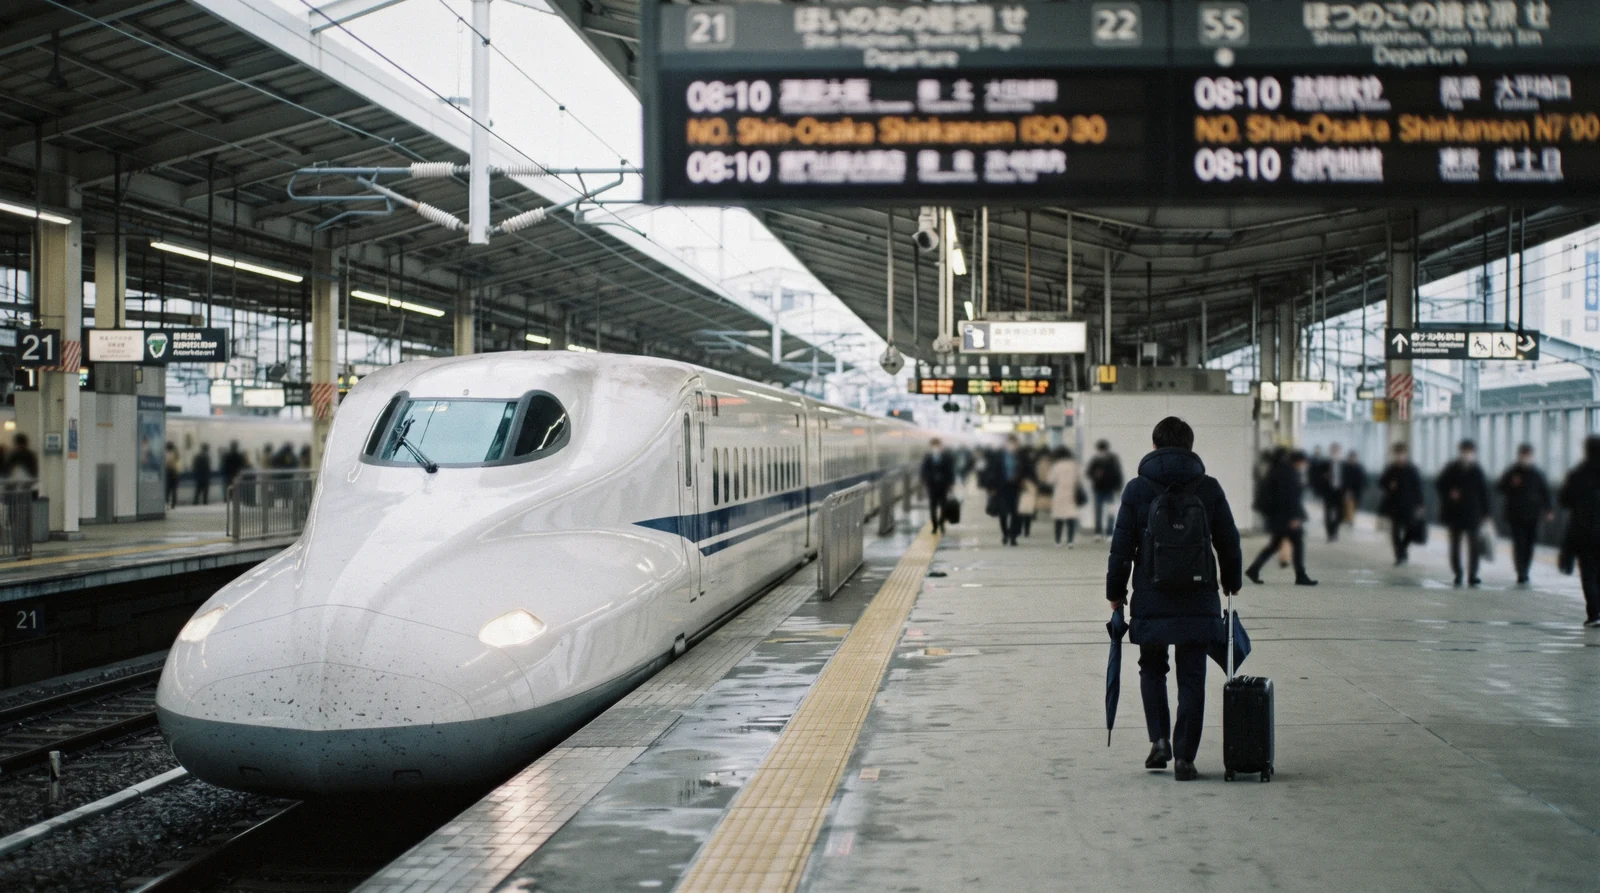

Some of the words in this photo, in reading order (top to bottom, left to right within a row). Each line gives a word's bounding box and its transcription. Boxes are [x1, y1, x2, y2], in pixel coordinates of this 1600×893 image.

[691, 13, 727, 42] 21
[1096, 9, 1137, 40] 22
[863, 49, 958, 71] Departure
[1372, 45, 1467, 67] Departure
[686, 80, 772, 113] 08:10
[1195, 76, 1281, 110] 08:10
[736, 116, 875, 145] Shin-Osaka
[879, 116, 1016, 144] Shinkansen
[1195, 115, 1241, 143] NO.
[1246, 113, 1391, 143] Shin-Osaka
[686, 150, 772, 183] 08:10
[1195, 147, 1281, 181] 08:10
[22, 334, 53, 360] 21
[16, 610, 37, 629] 21
